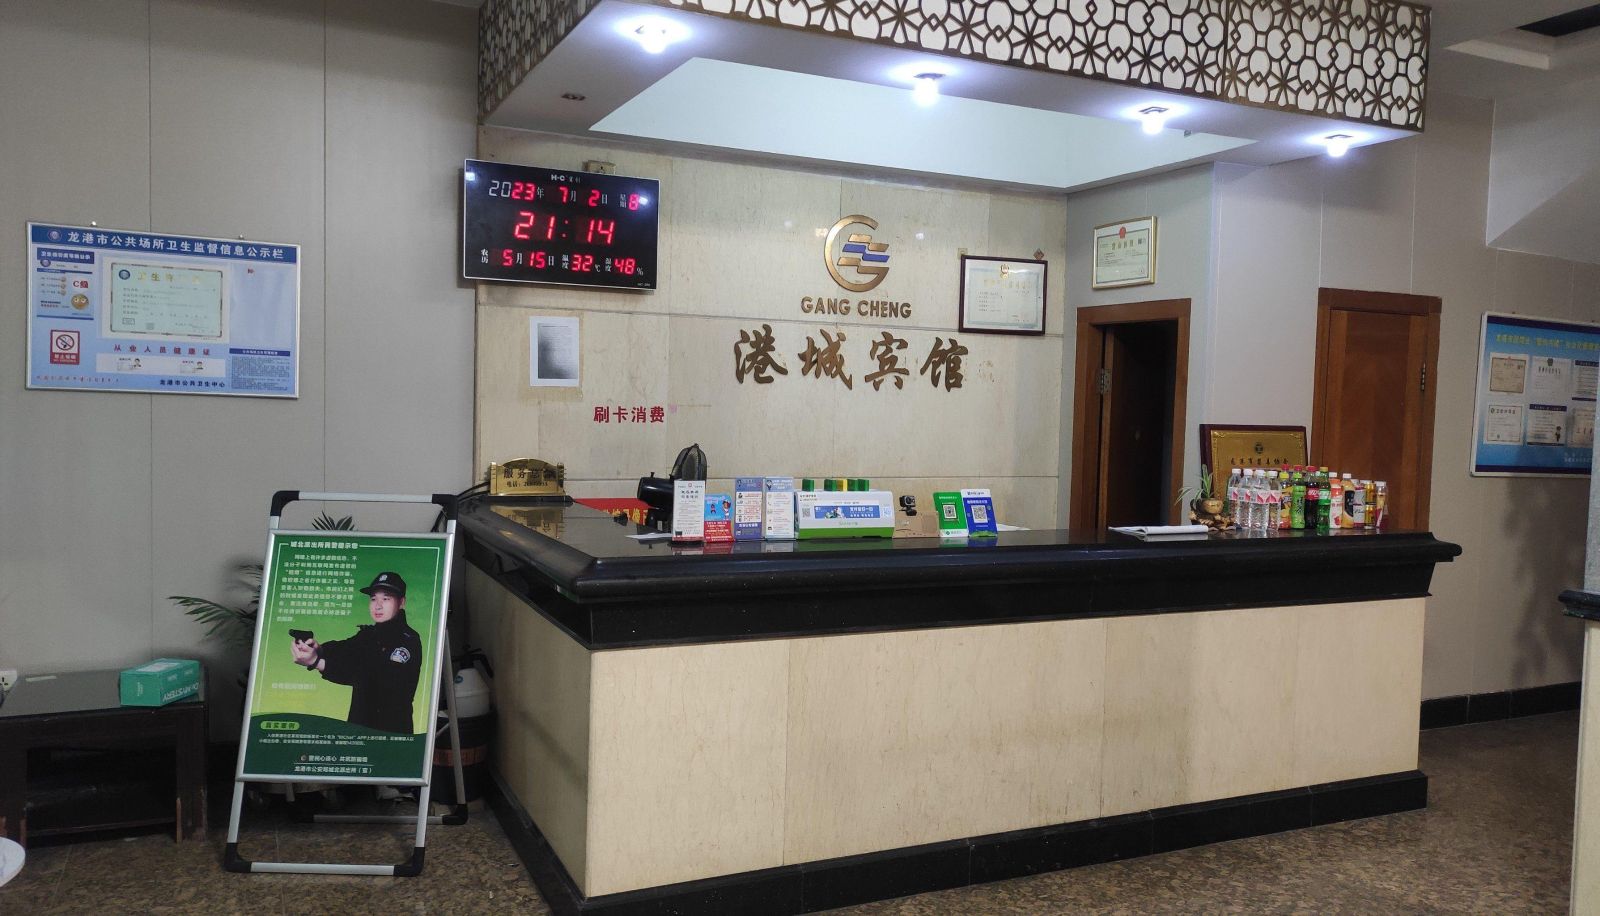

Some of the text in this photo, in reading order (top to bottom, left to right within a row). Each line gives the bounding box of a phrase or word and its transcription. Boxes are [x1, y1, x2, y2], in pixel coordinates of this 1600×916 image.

[488, 180, 545, 201] 2023年
[559, 187, 577, 203] 7月
[588, 190, 608, 207] 2日
[514, 211, 616, 245] 21:14
[68, 231, 284, 259] 龙港市公共场所卫生监督信息公示栏
[502, 249, 523, 267] 5月
[529, 251, 555, 269] 15日
[800, 296, 912, 318] GANG CHENG
[114, 344, 210, 356] 从业人员健康证
[733, 323, 969, 393] 港城宾馆
[159, 379, 225, 388] 龙港市公共卫生中心
[593, 406, 665, 423] 刷卡消费
